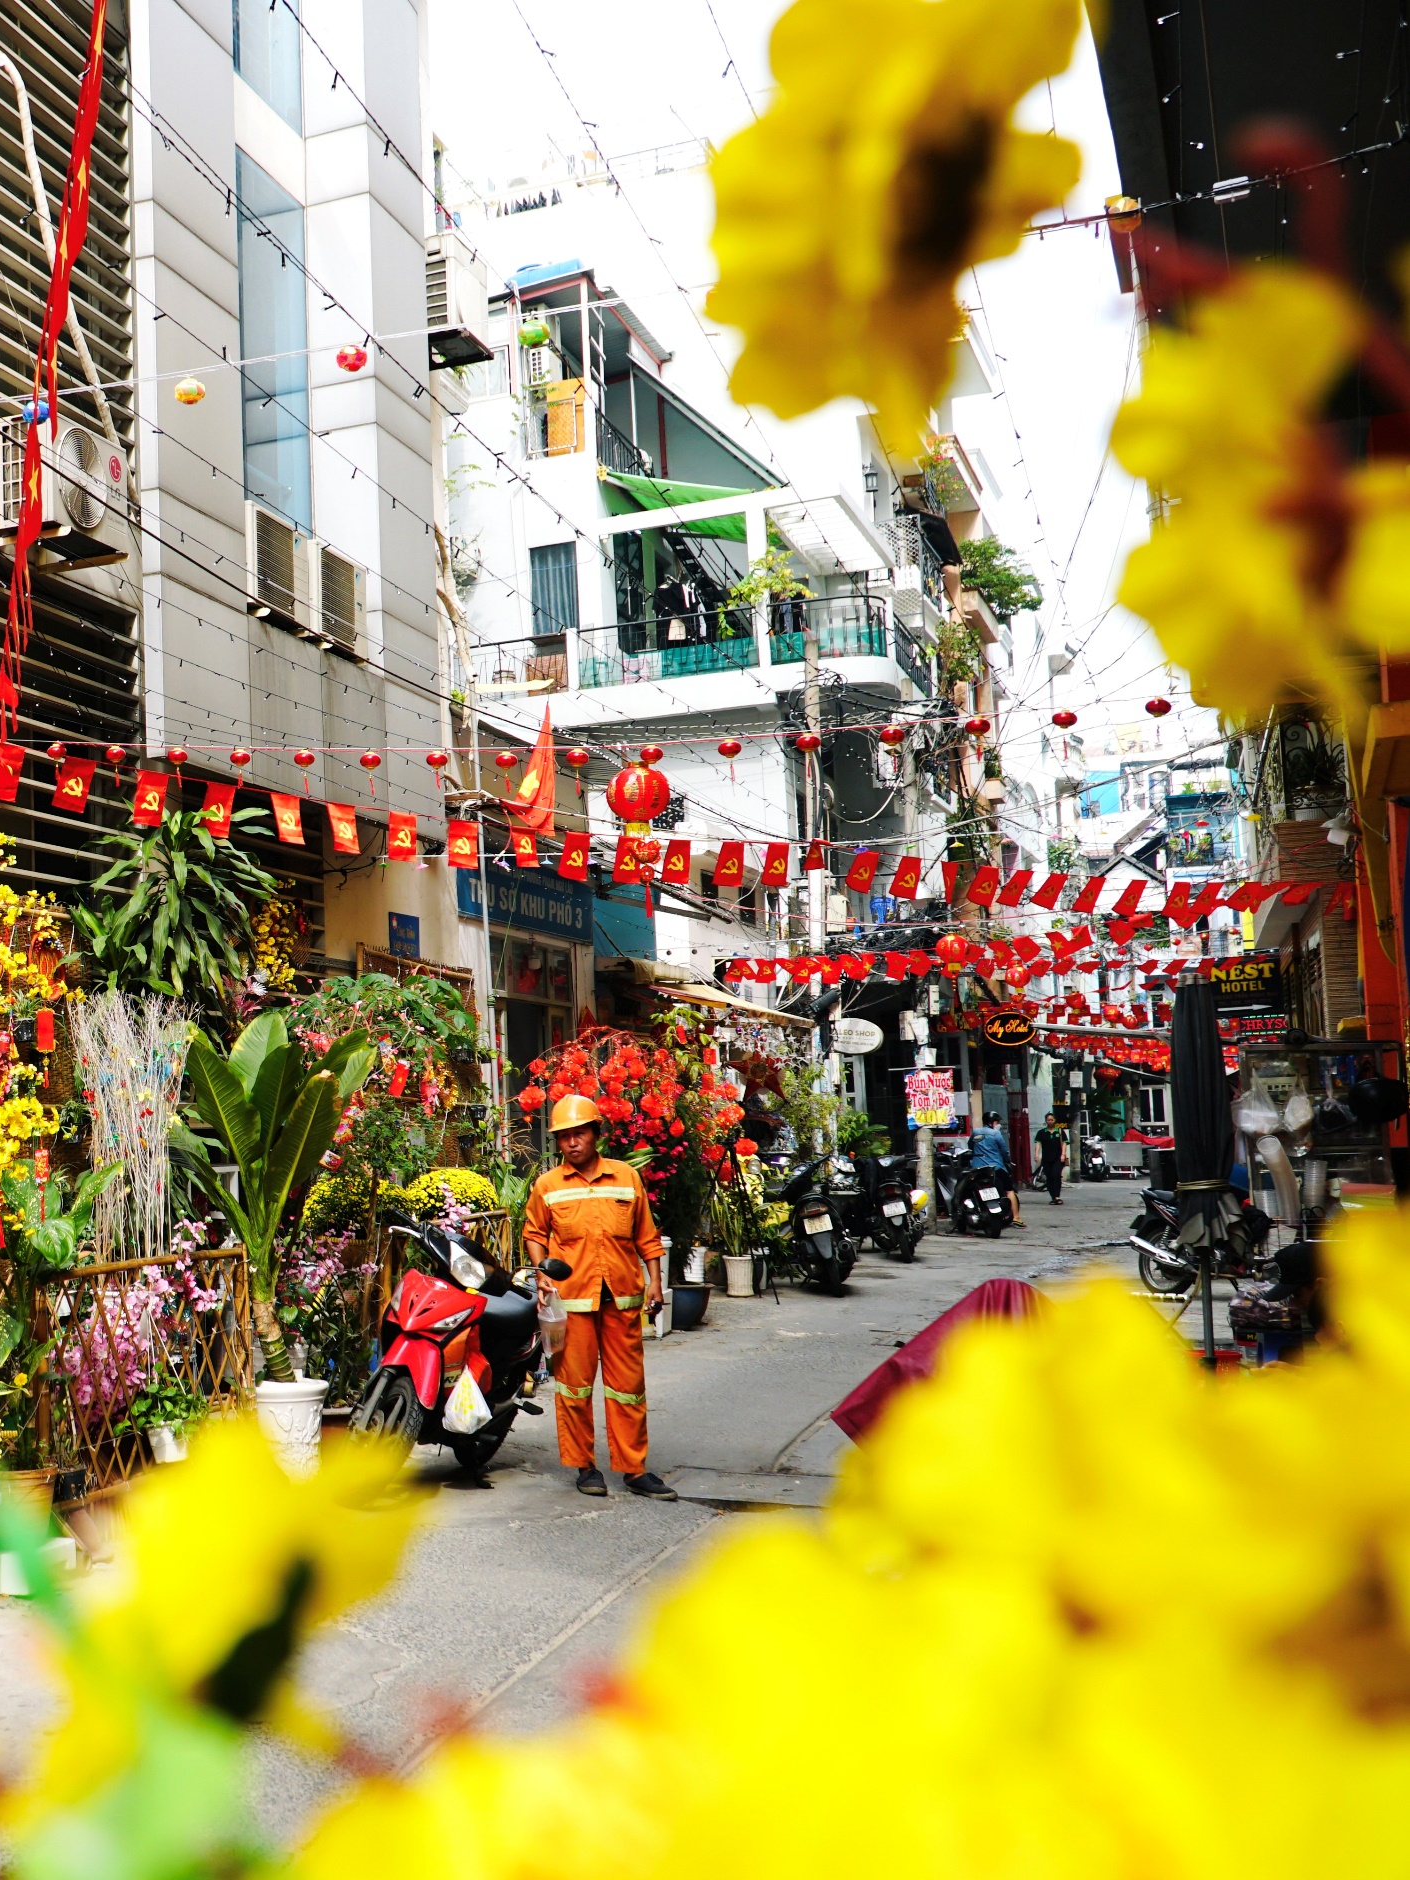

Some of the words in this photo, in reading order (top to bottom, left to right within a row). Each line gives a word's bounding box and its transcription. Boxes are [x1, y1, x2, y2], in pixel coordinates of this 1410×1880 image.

[520, 892, 546, 920] KHU
[549, 897, 573, 926] PHỐ
[575, 907, 583, 929] 3
[1210, 962, 1275, 982] NEST
[1221, 980, 1266, 993] HOTEL
[987, 1019, 1004, 1038] My
[1005, 1019, 1030, 1033] Hotel
